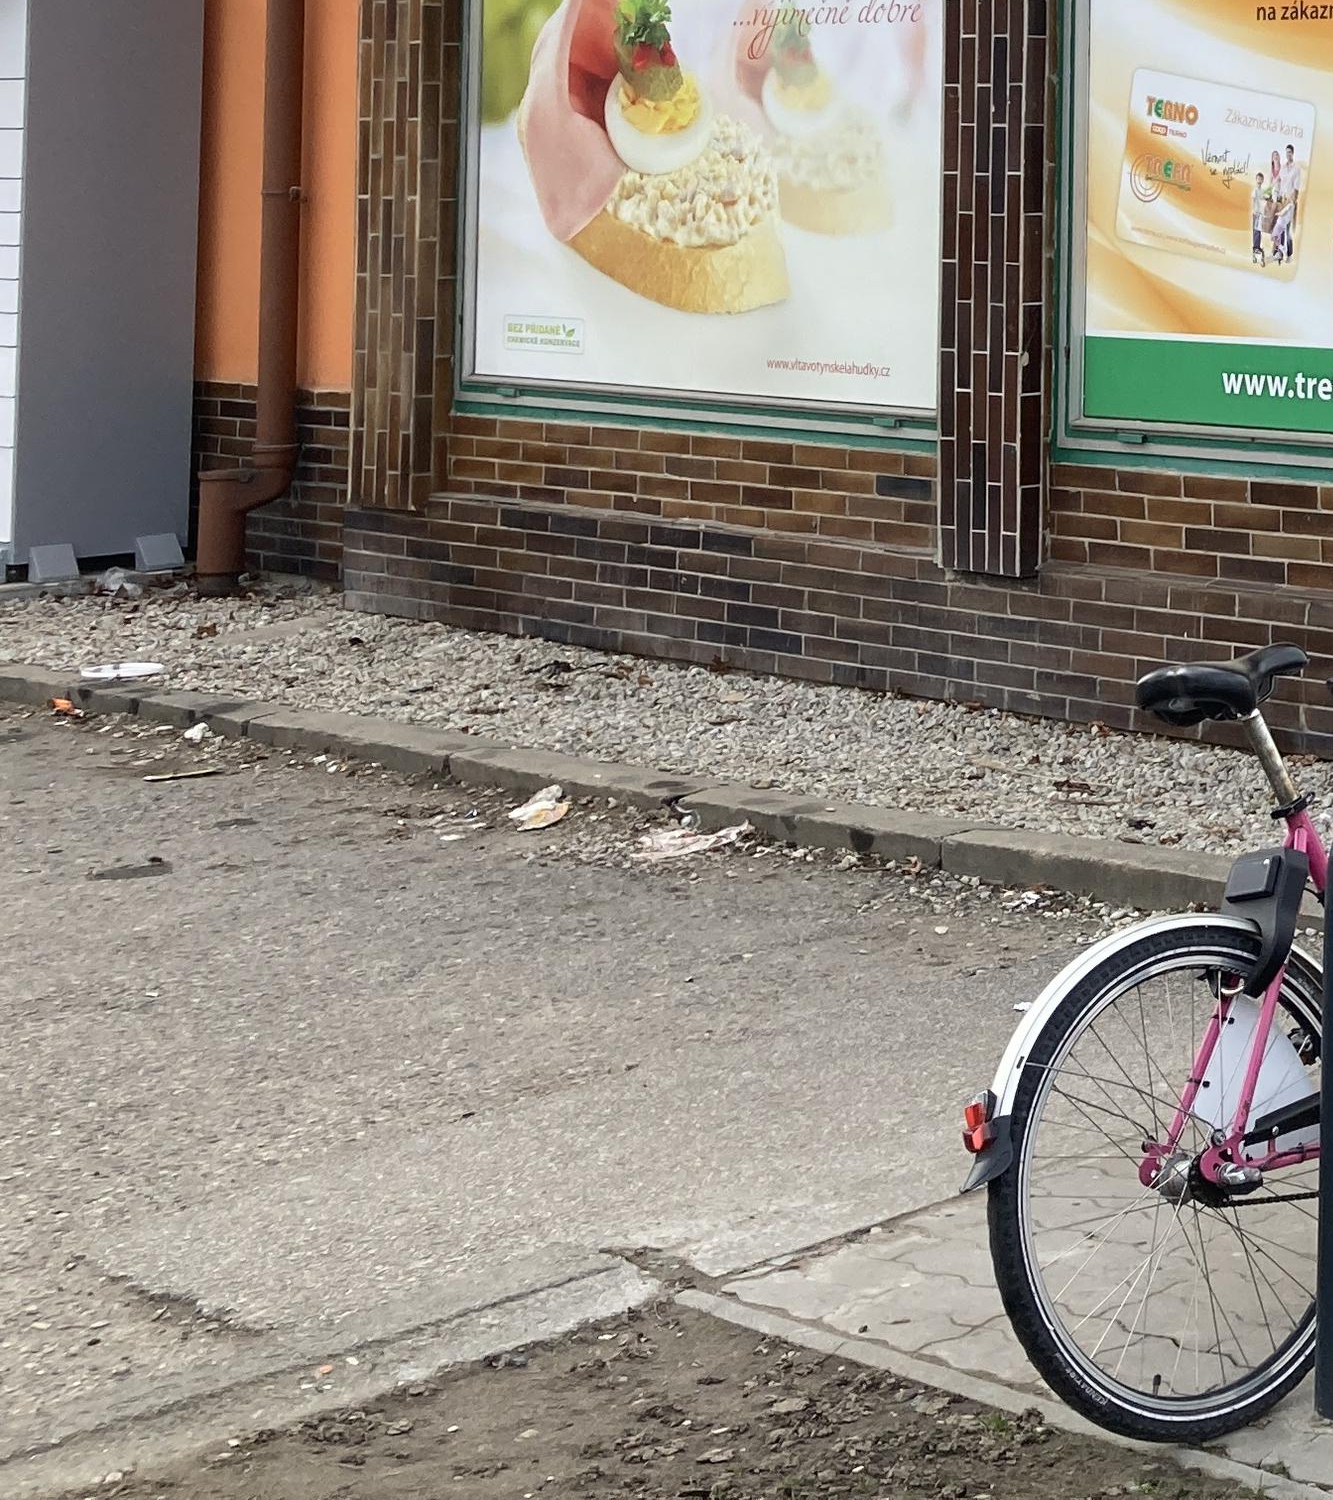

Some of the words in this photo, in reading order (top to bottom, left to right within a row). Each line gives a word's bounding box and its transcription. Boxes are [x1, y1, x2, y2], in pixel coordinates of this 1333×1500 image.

[1256, 4, 1276, 21] na
[1224, 108, 1279, 133] Zákaznická
[1279, 121, 1304, 139] karta
